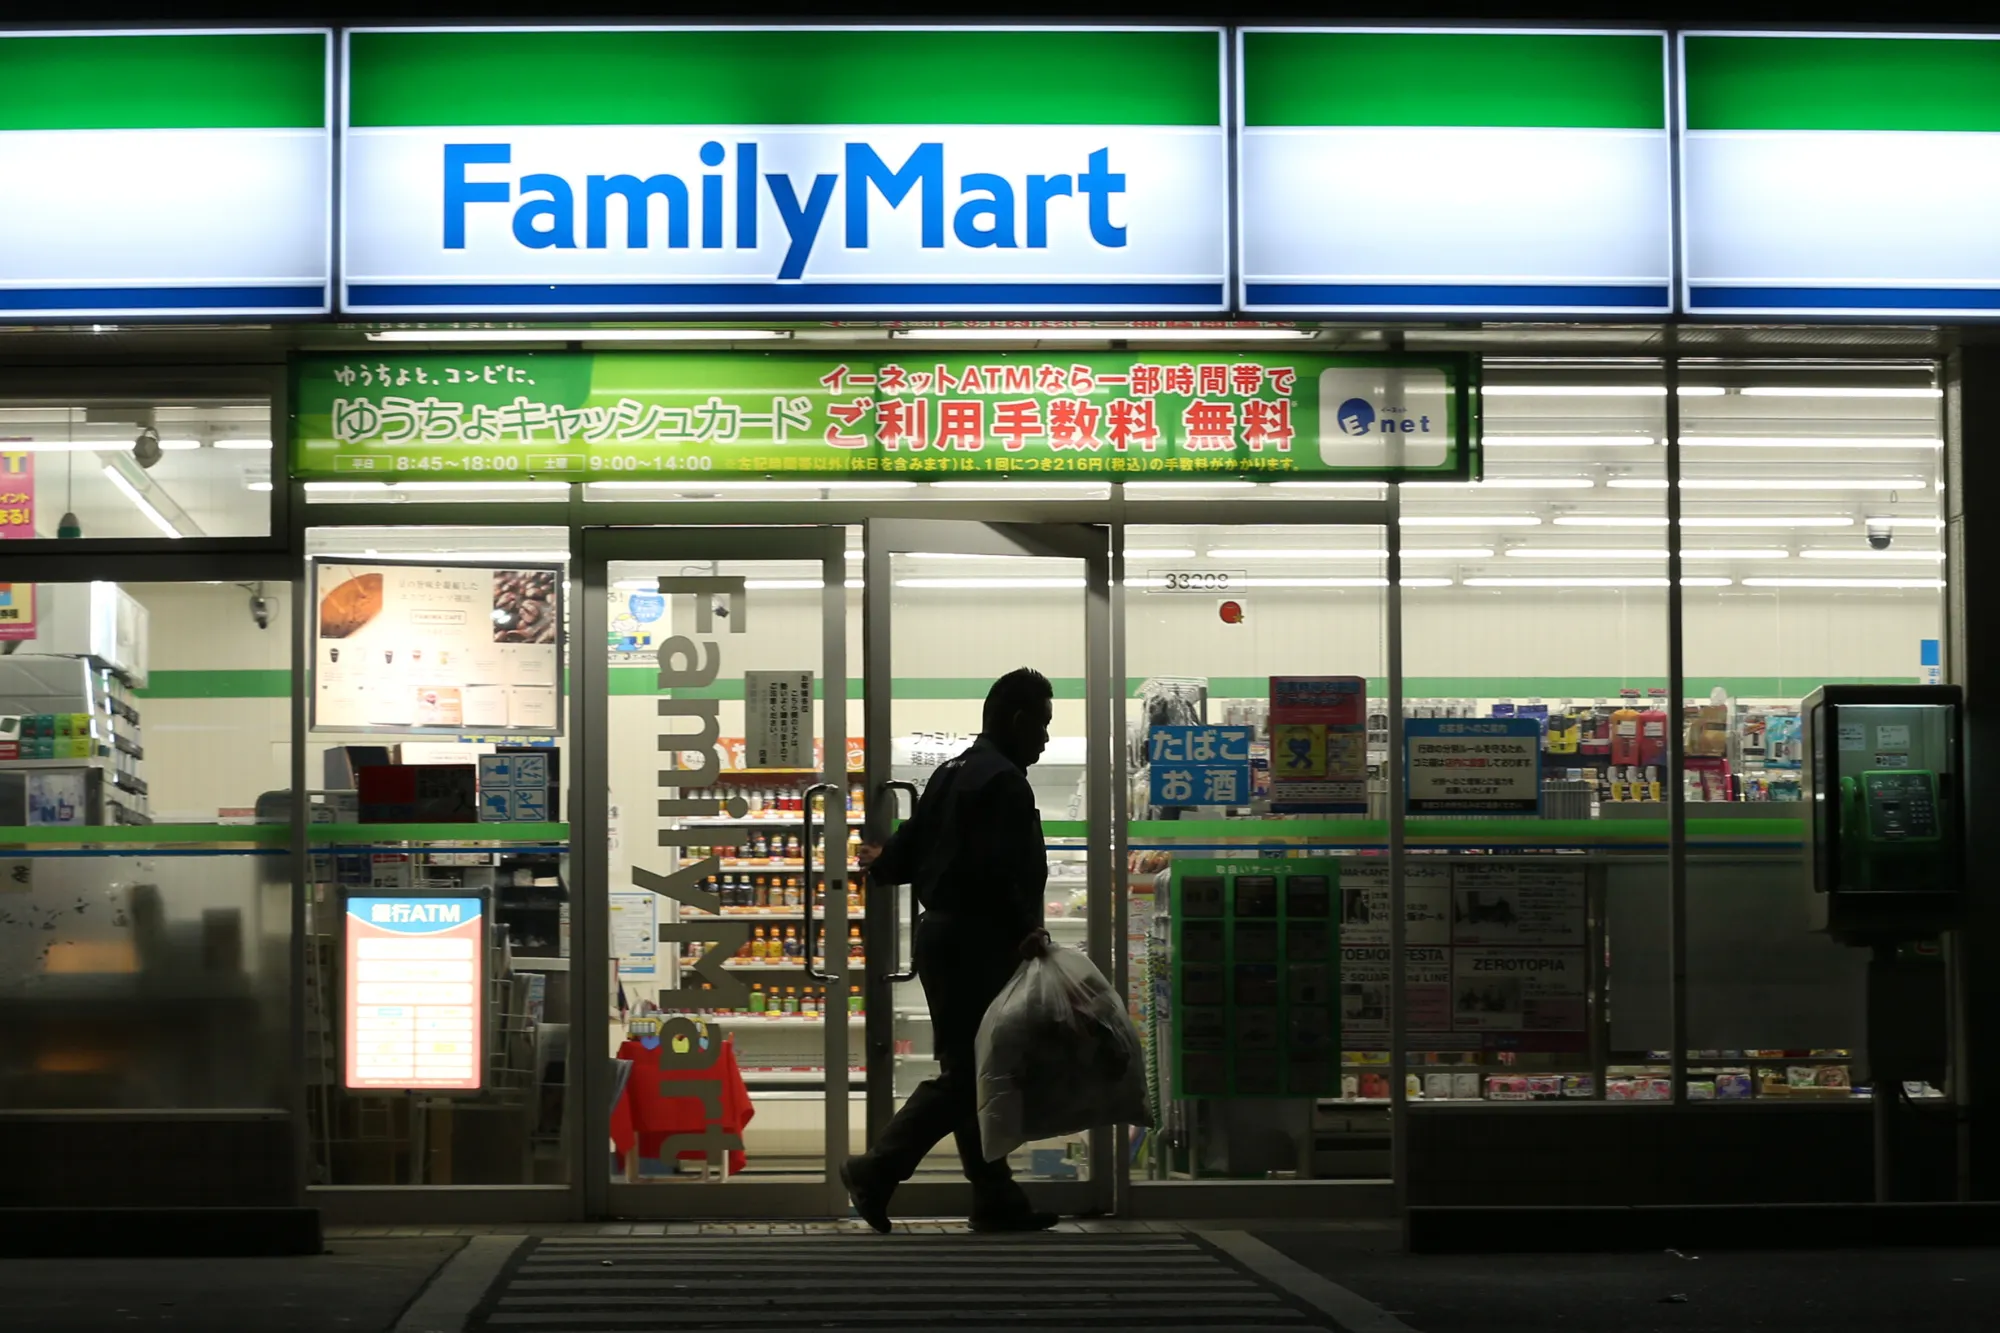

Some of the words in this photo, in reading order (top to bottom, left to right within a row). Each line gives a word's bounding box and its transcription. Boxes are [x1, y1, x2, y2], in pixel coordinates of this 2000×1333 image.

[443, 141, 1128, 280] FamilyMart
[335, 365, 536, 387] ゆうちょと、コンビに、
[820, 362, 1297, 395] イーネットATMなら一部時間帯で
[331, 395, 813, 445] ゆうちょキャッシュカード
[824, 397, 1158, 451] ご利用手数料
[1152, 729, 1248, 762] たばこ
[1161, 770, 1237, 802] お酒
[632, 575, 746, 1166] FamilyMart
[371, 903, 461, 923] 銀行ATM
[1473, 959, 1565, 972] ZEROTOPIA
